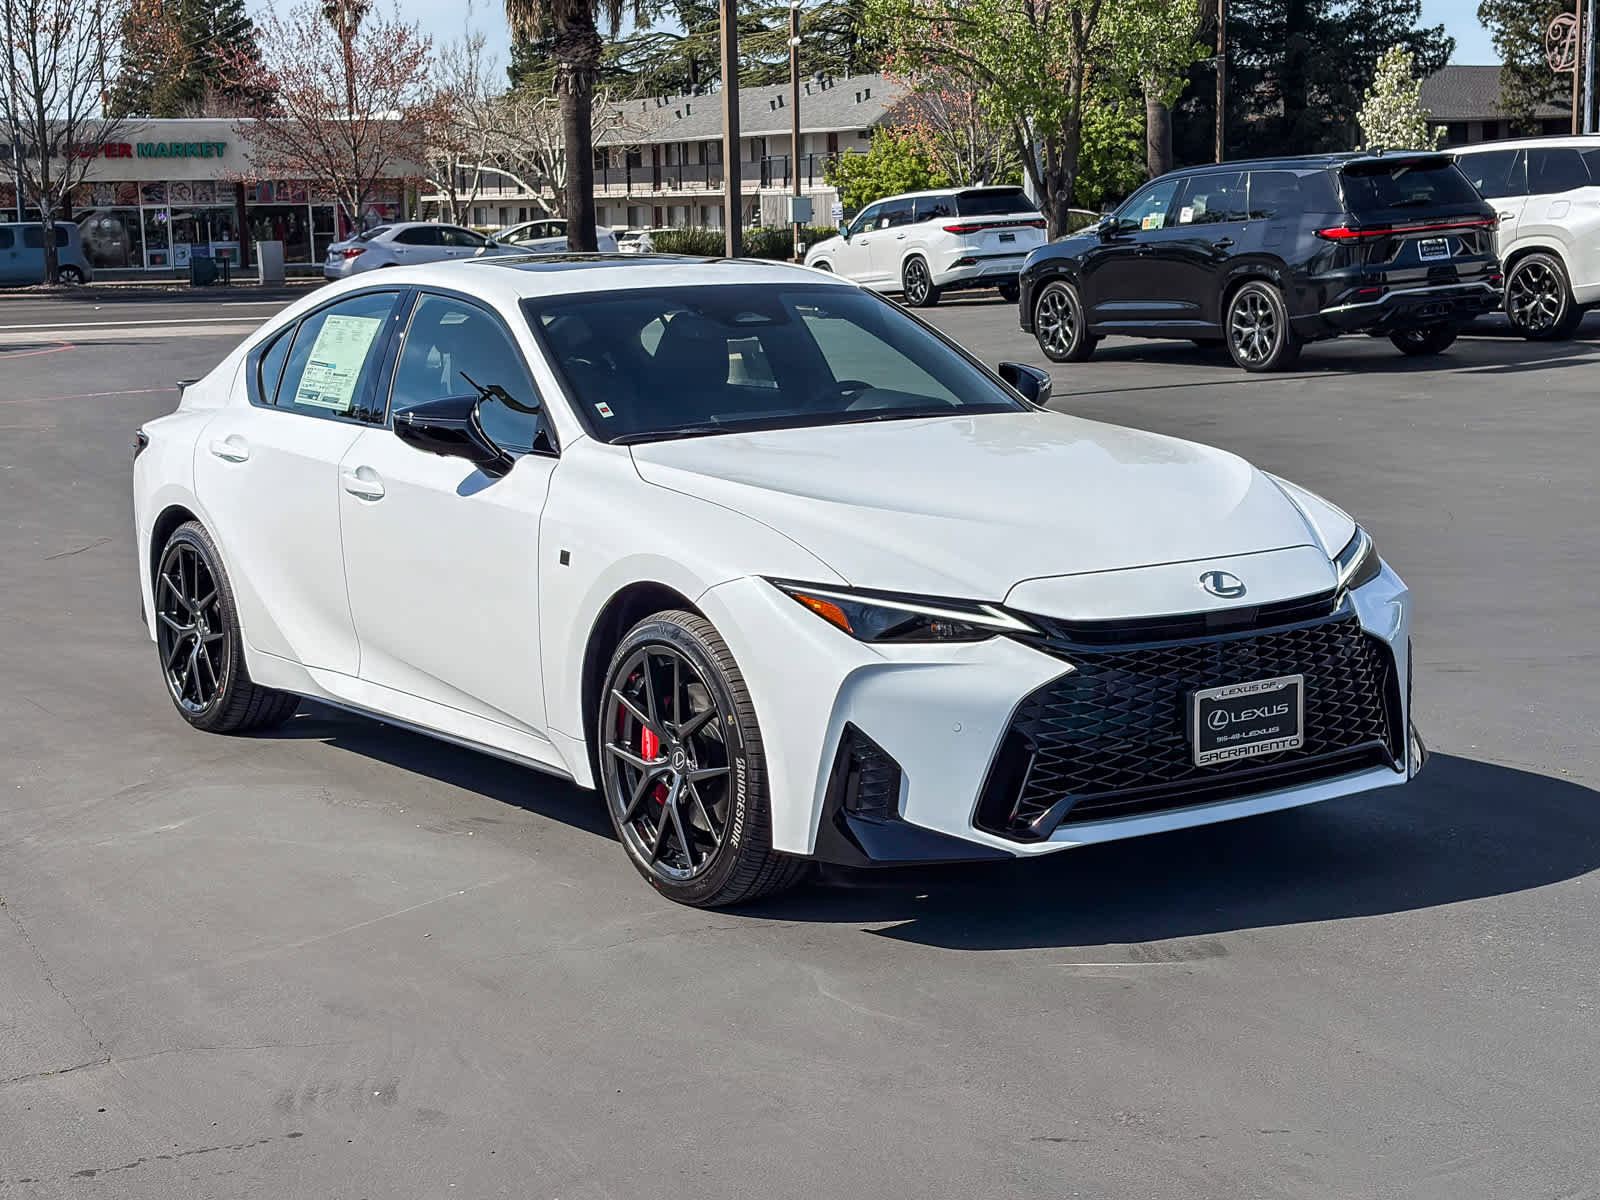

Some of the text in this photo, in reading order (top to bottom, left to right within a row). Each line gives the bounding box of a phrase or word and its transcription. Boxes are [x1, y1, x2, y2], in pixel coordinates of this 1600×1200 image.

[136, 141, 228, 158] MARKET
[1221, 681, 1277, 697] LEXUS OF
[1231, 703, 1289, 723] LEXUS
[1200, 738, 1300, 764] SACRAMENTO
[730, 756, 746, 849] BRIDGESTONE
